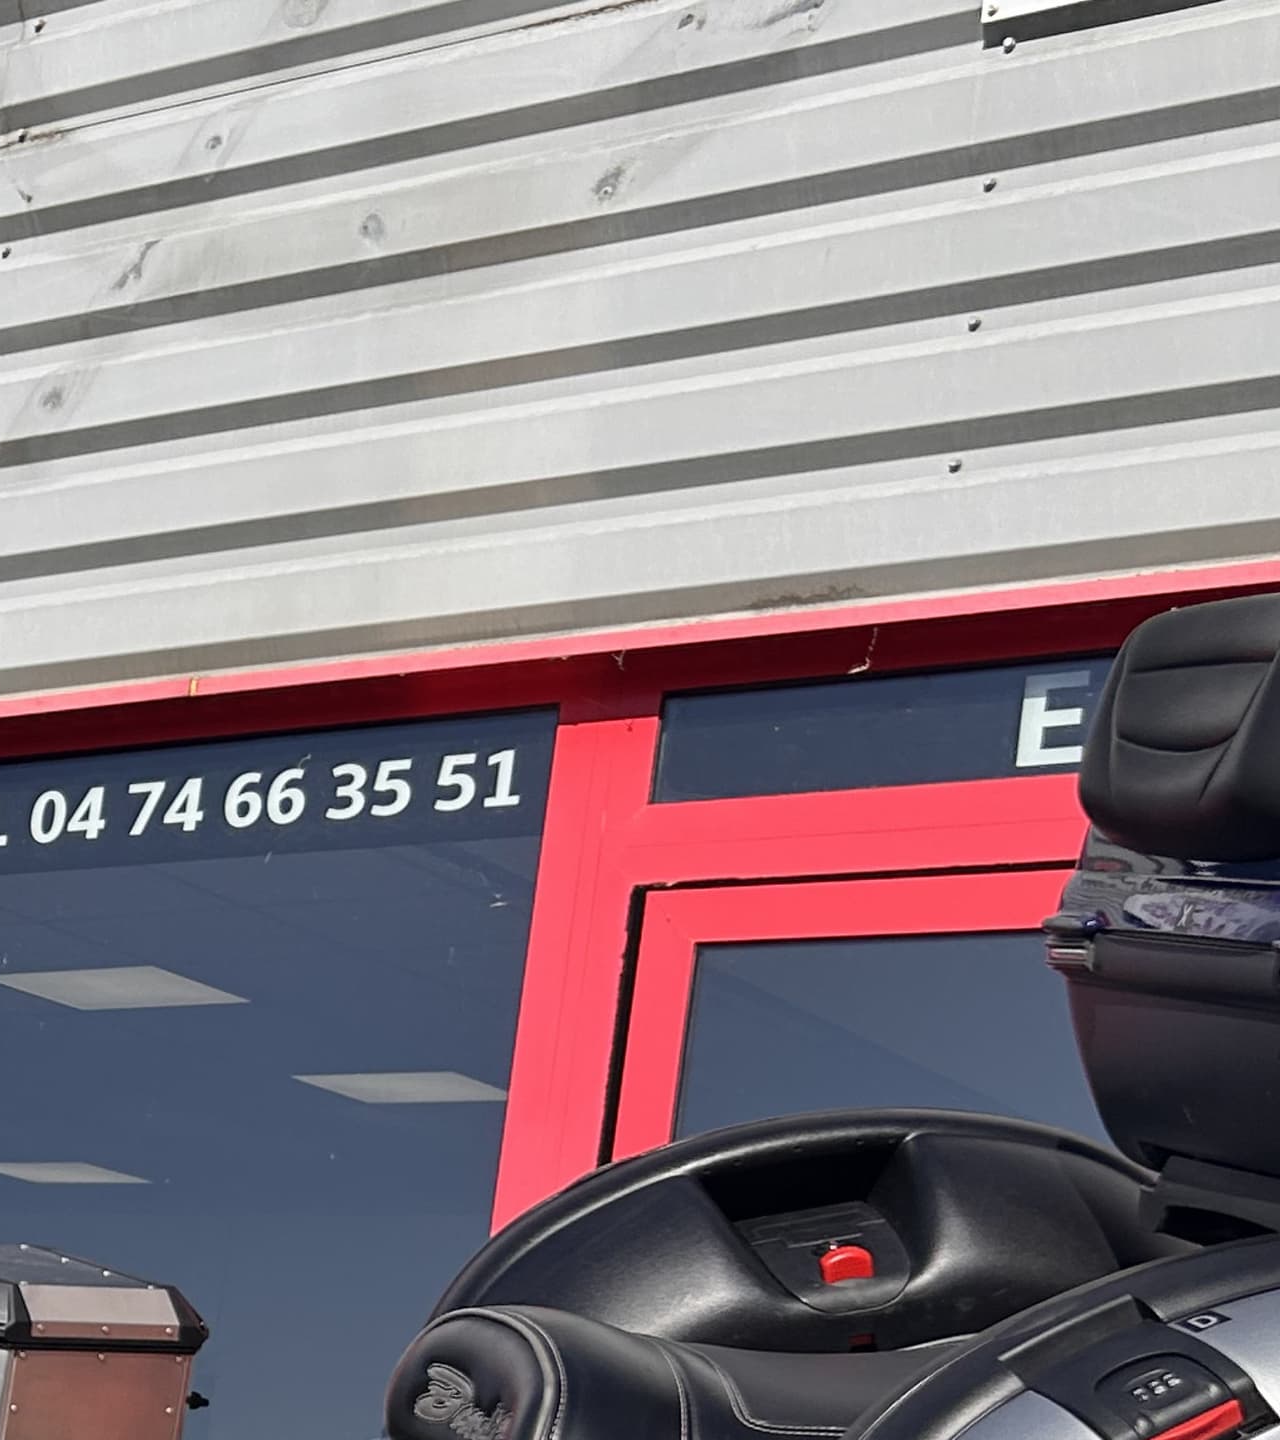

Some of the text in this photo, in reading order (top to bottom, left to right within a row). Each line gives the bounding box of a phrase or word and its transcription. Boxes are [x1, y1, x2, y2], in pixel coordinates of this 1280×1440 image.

[29, 787, 106, 843] 04
[127, 778, 204, 837] 74
[223, 768, 307, 829] 66
[326, 758, 413, 820] 35
[434, 748, 521, 811] 51
